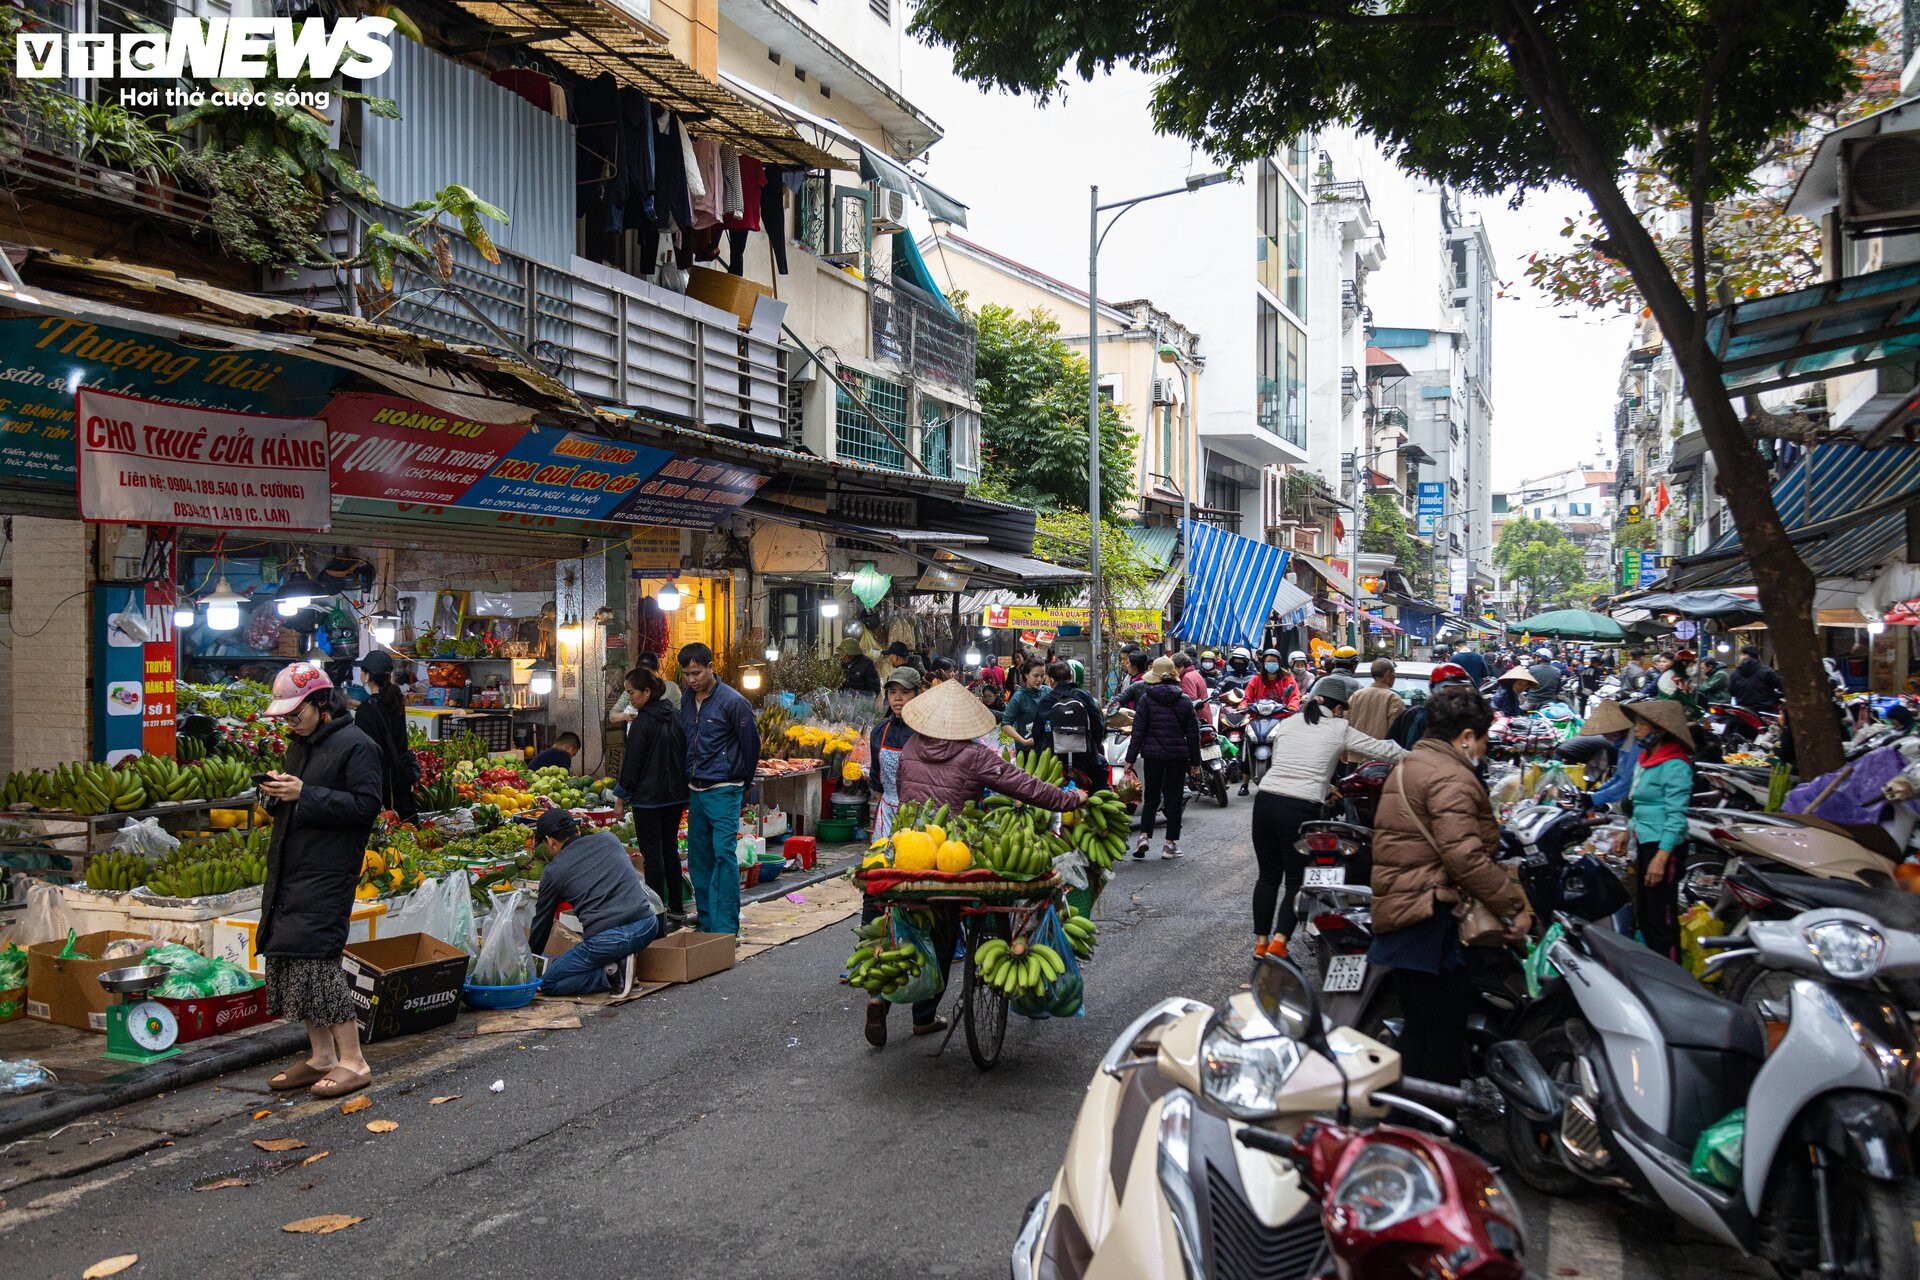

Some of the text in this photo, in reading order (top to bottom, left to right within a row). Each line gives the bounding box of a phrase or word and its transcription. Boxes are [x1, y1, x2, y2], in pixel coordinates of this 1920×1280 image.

[35, 317, 283, 392] Thượng Hải
[371, 405, 448, 432] HOÀNG
[86, 415, 137, 452] CHO
[142, 426, 208, 460] THUÊ
[208, 427, 254, 465] CỬA
[553, 438, 638, 465] OANH LONG
[342, 436, 422, 474] QUAY
[416, 445, 444, 464] GIA
[442, 449, 499, 471] TRUYỀN
[119, 471, 305, 500] Liên hệ: 0904.189.540 (A. CƯỜNG)
[489, 458, 641, 494] HOA QUẢ CAO CẤP
[400, 490, 424, 498] 0912
[523, 488, 542, 498] GIA
[245, 505, 262, 523] (C.
[264, 507, 291, 524] LAN)
[1316, 646, 1333, 656] Spa
[403, 988, 458, 1010] Sunrise
